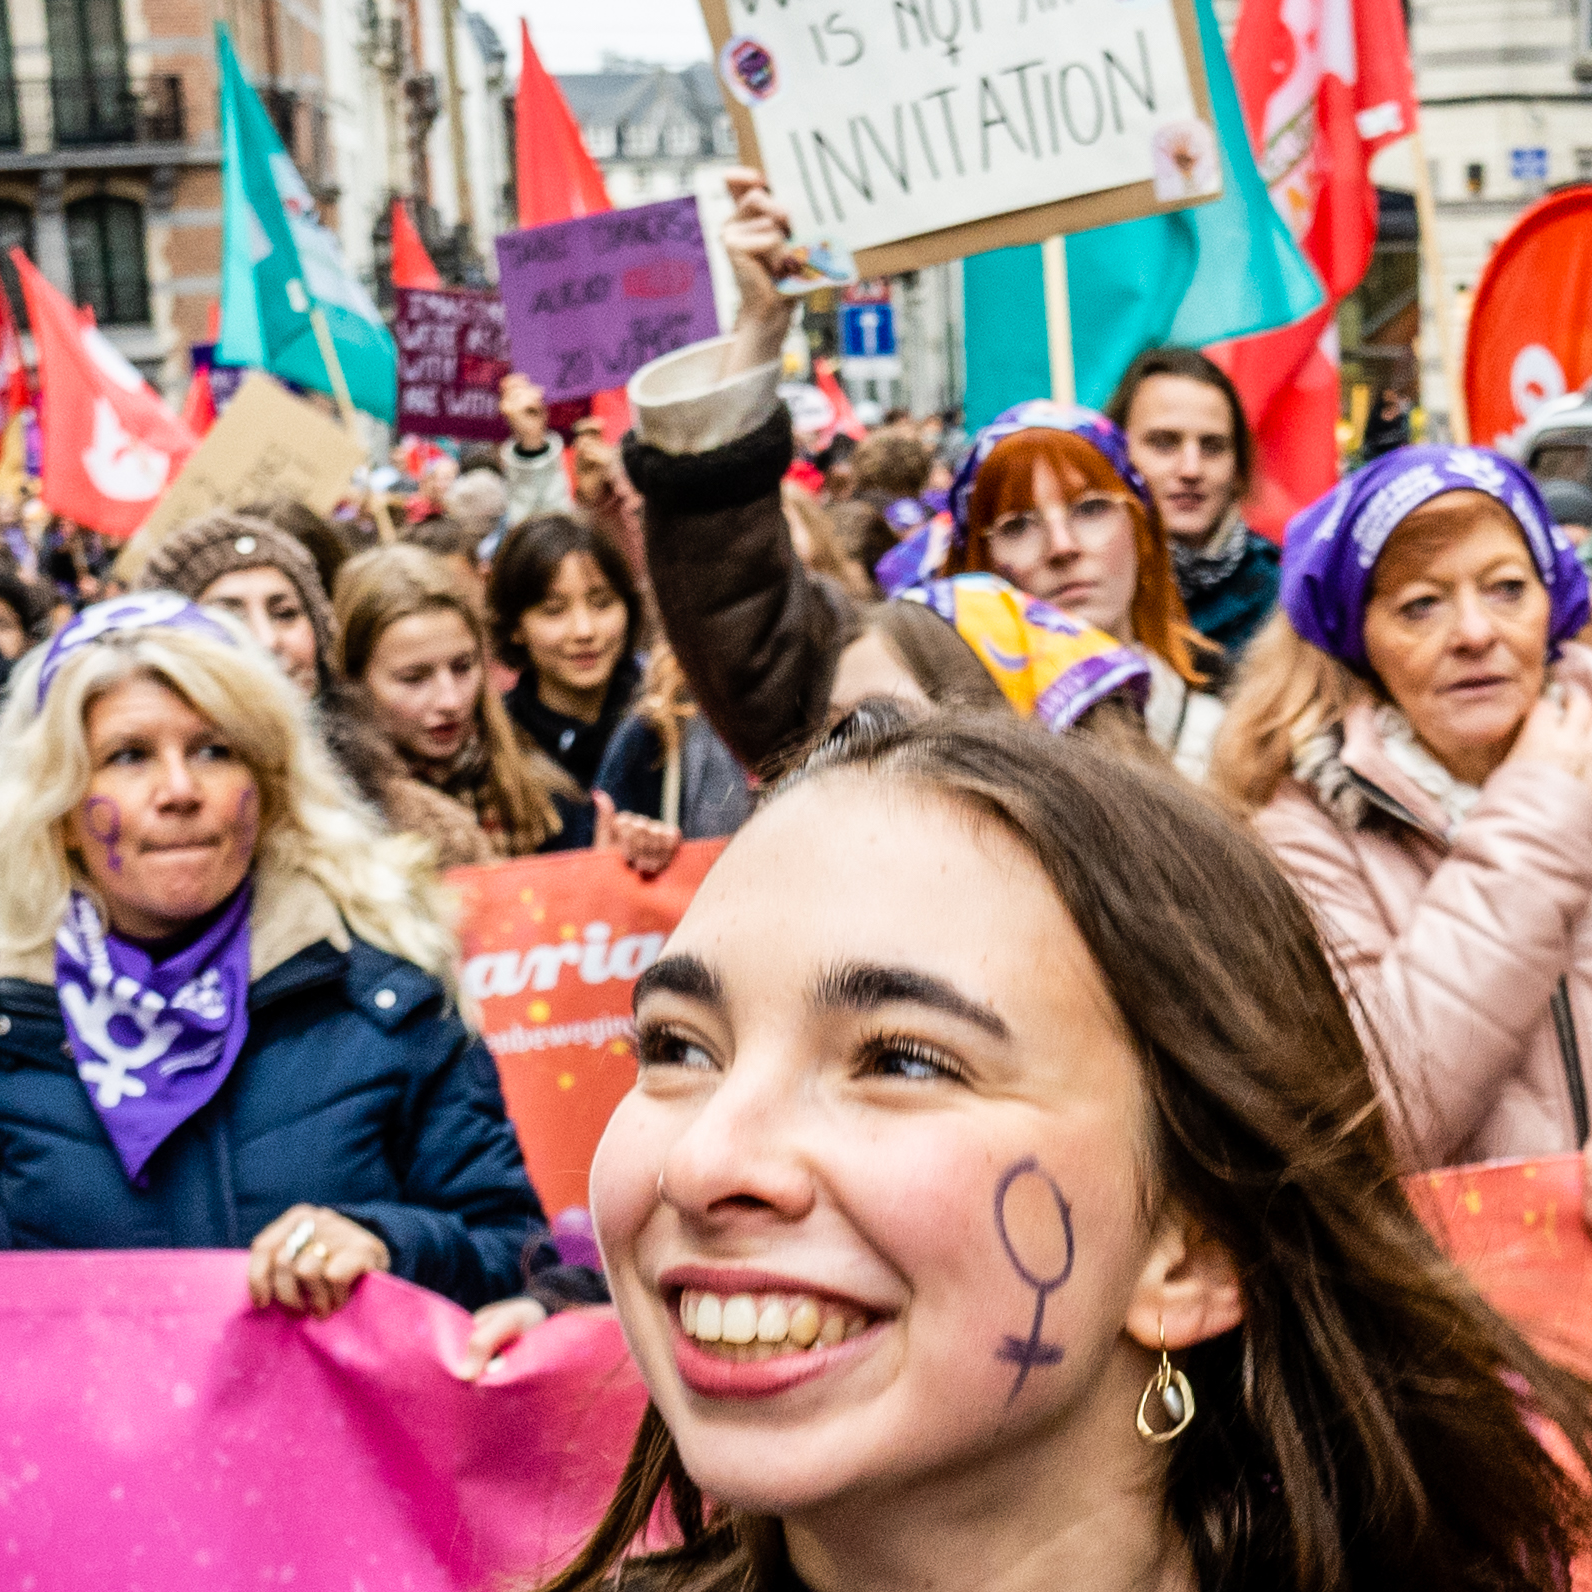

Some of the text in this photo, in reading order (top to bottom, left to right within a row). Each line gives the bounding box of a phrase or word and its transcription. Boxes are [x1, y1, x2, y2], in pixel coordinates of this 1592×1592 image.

[809, 11, 865, 66] IS
[789, 29, 1156, 226] INVITATION
[463, 920, 665, 1001] aria
